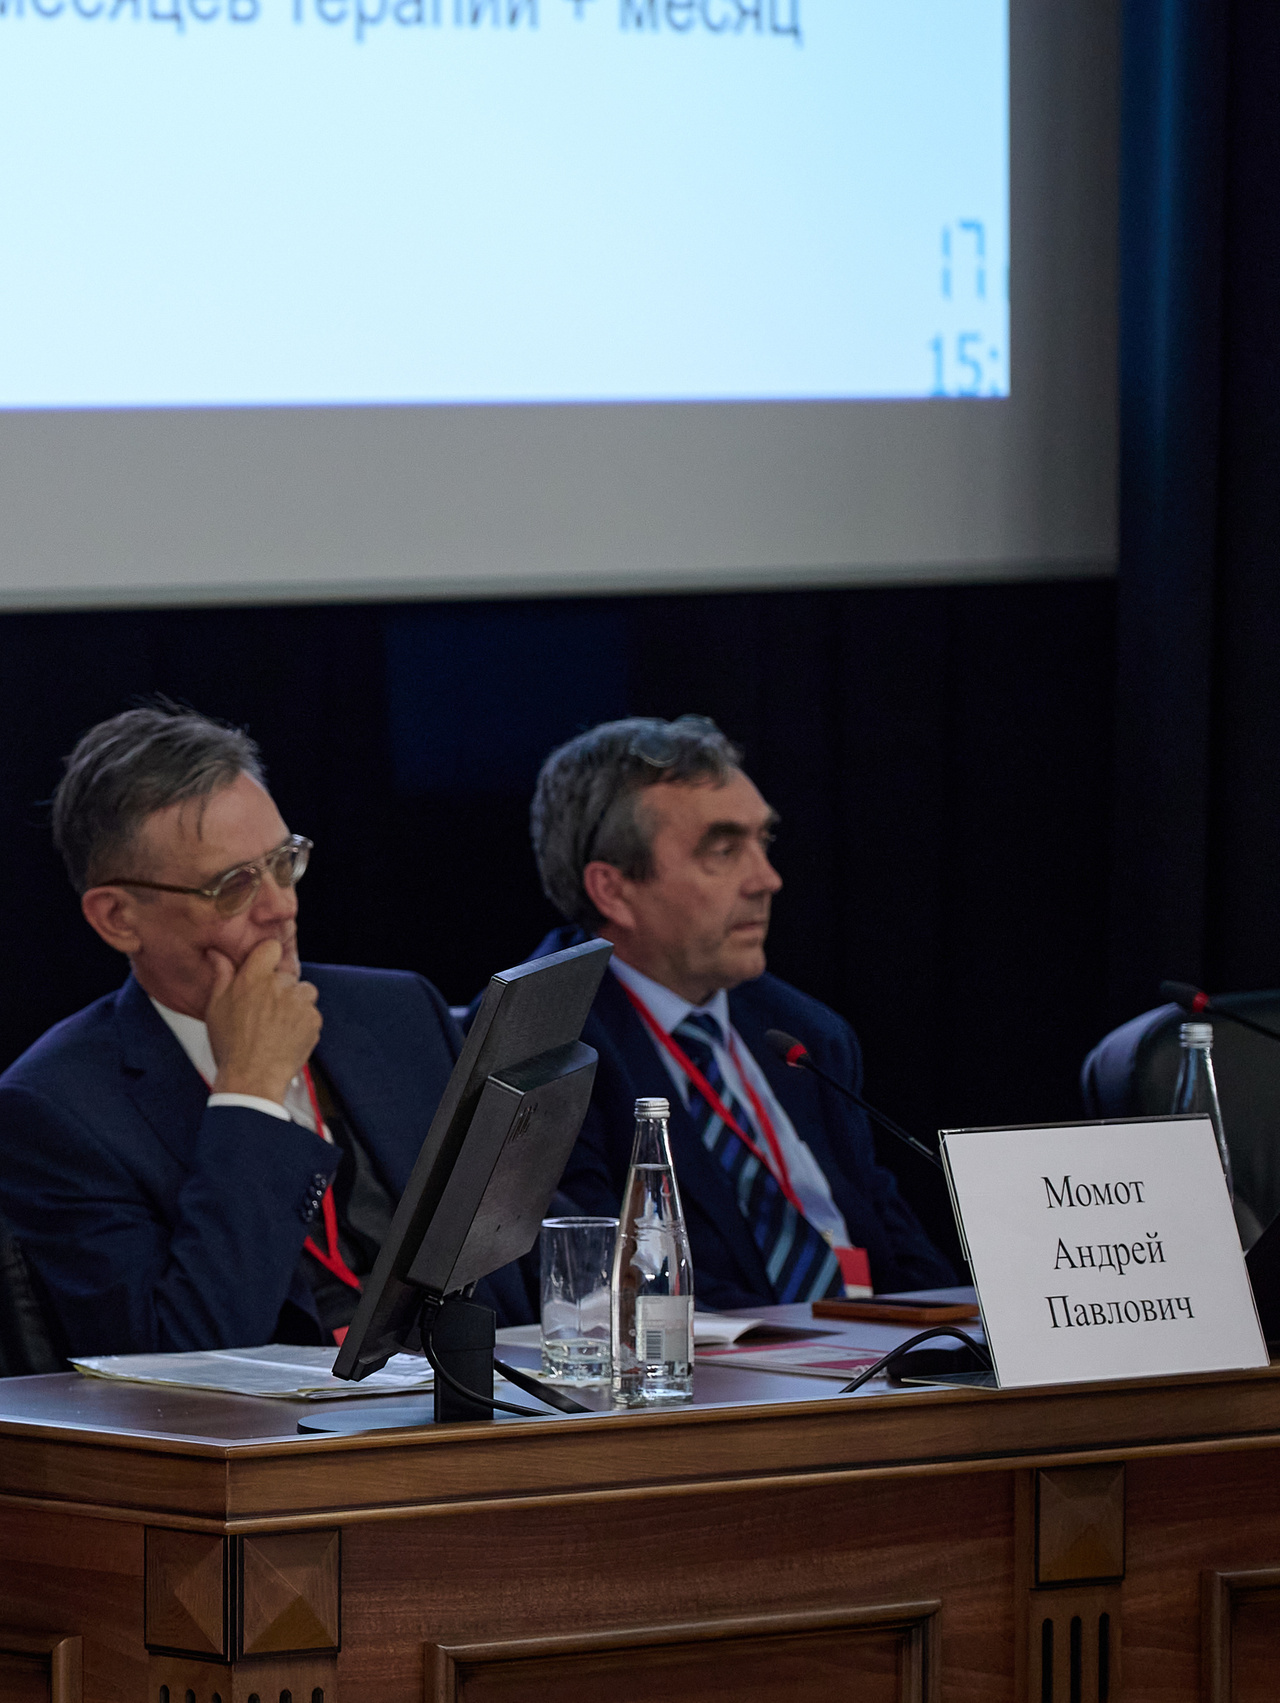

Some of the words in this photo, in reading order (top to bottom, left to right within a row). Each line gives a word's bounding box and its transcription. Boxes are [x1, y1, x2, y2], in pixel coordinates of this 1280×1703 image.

[1042, 1176, 1143, 1208] Момот
[1054, 1232, 1165, 1275] Андрей
[1045, 1296, 1194, 1328] Павлович
